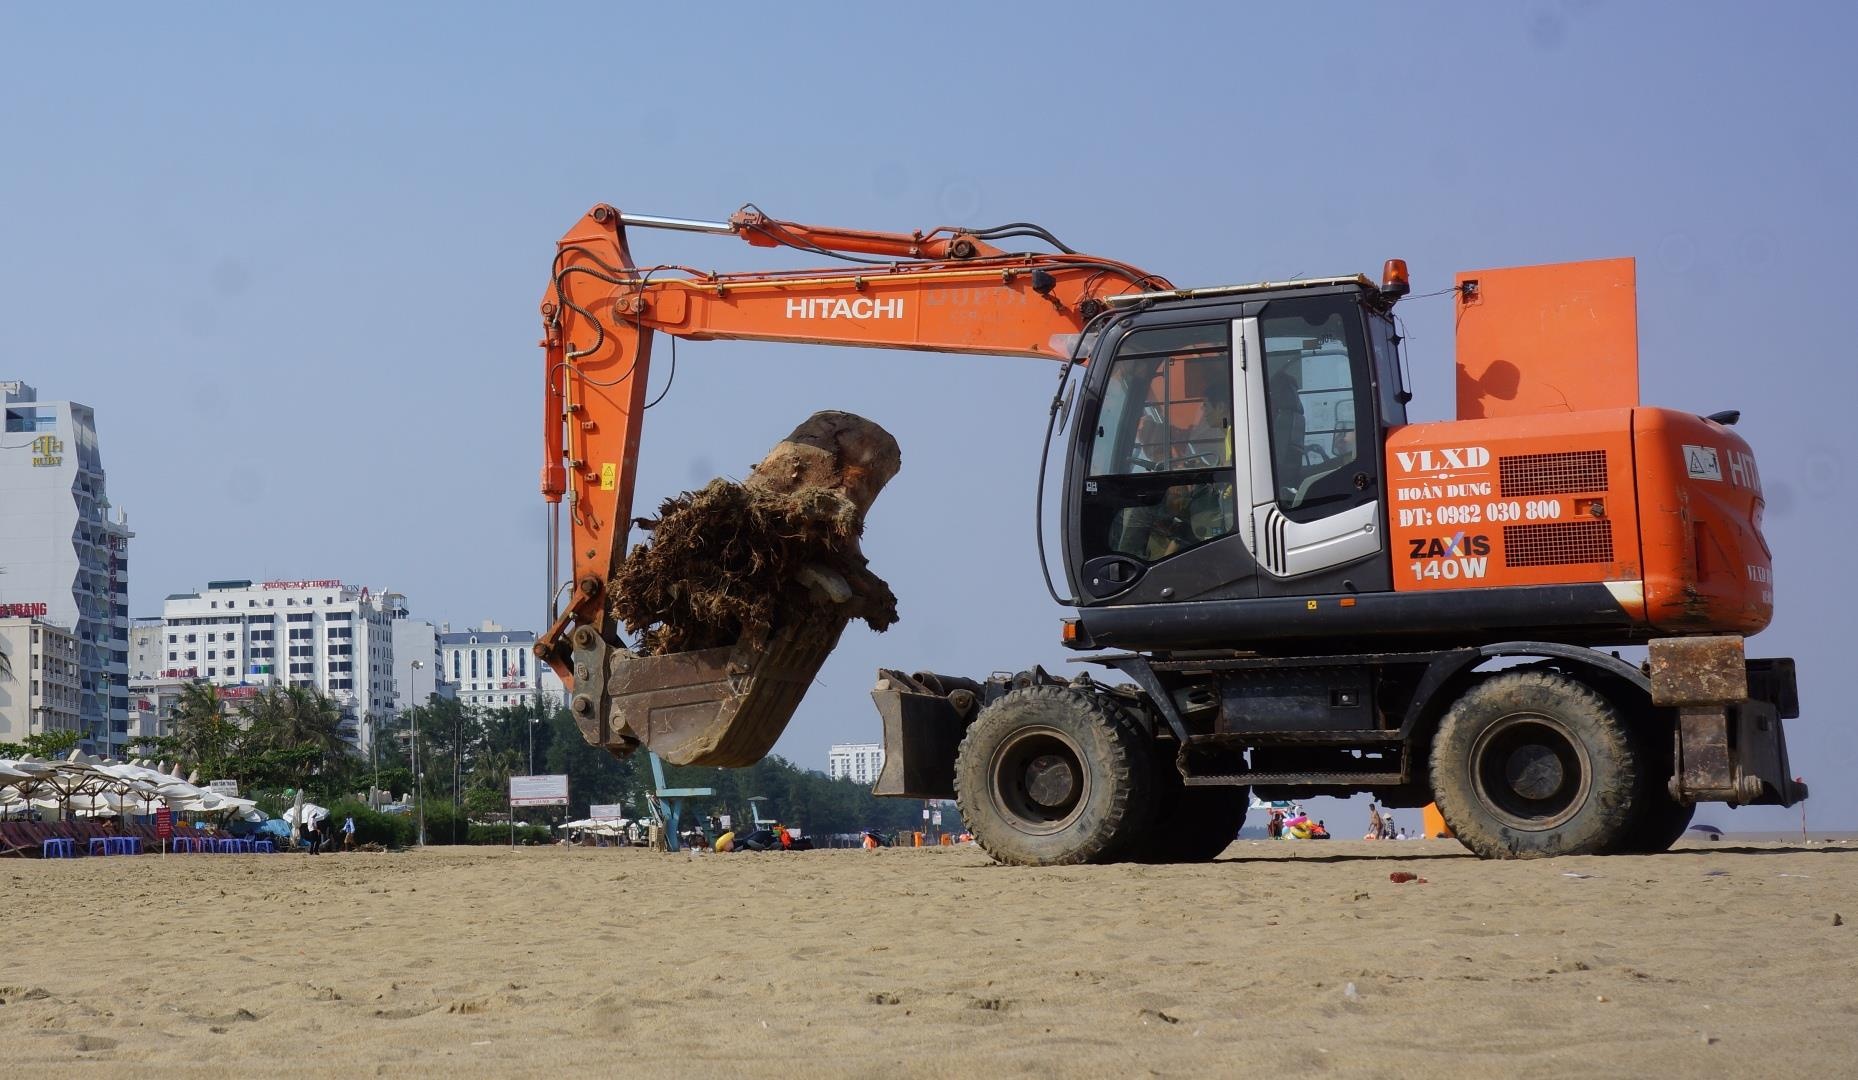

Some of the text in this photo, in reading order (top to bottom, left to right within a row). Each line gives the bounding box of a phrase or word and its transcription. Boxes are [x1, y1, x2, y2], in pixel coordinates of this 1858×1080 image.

[786, 298, 904, 319] HITACHI
[1395, 446, 1490, 472] VLXD
[1398, 482, 1492, 501] HOÀN DUNG
[1436, 504, 1482, 525] 0982
[1486, 501, 1521, 521] 030
[1525, 499, 1561, 520] 800
[1409, 531, 1491, 559] ZAXIS
[1410, 556, 1488, 581] 140W
